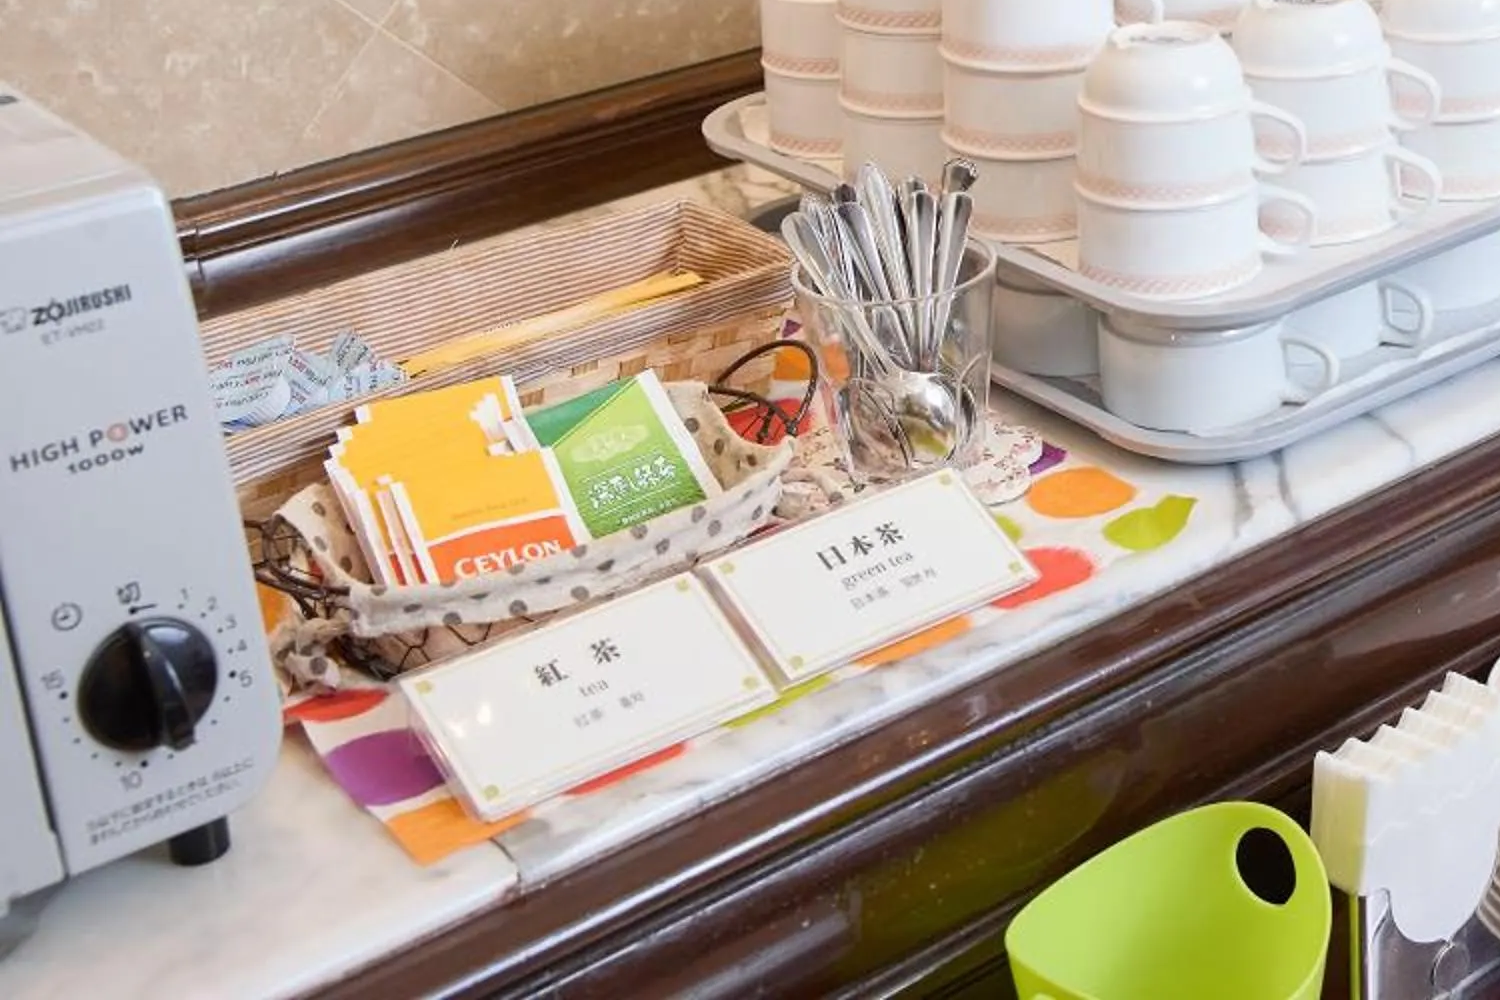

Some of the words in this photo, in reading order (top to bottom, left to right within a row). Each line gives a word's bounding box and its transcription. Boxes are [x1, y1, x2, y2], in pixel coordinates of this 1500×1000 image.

[31, 284, 131, 326] ZOJIRUSHI
[10, 437, 80, 472] HIGH
[89, 404, 189, 448] POWER
[817, 521, 905, 571] 日本茶
[454, 539, 561, 579] CEYLON
[841, 562, 888, 591] green
[888, 552, 914, 568] tea
[207, 597, 218, 611] 2
[226, 614, 237, 630] 3
[236, 639, 248, 651] 4
[239, 671, 252, 688] 5
[579, 679, 609, 697] tea
[120, 770, 143, 790] 10
